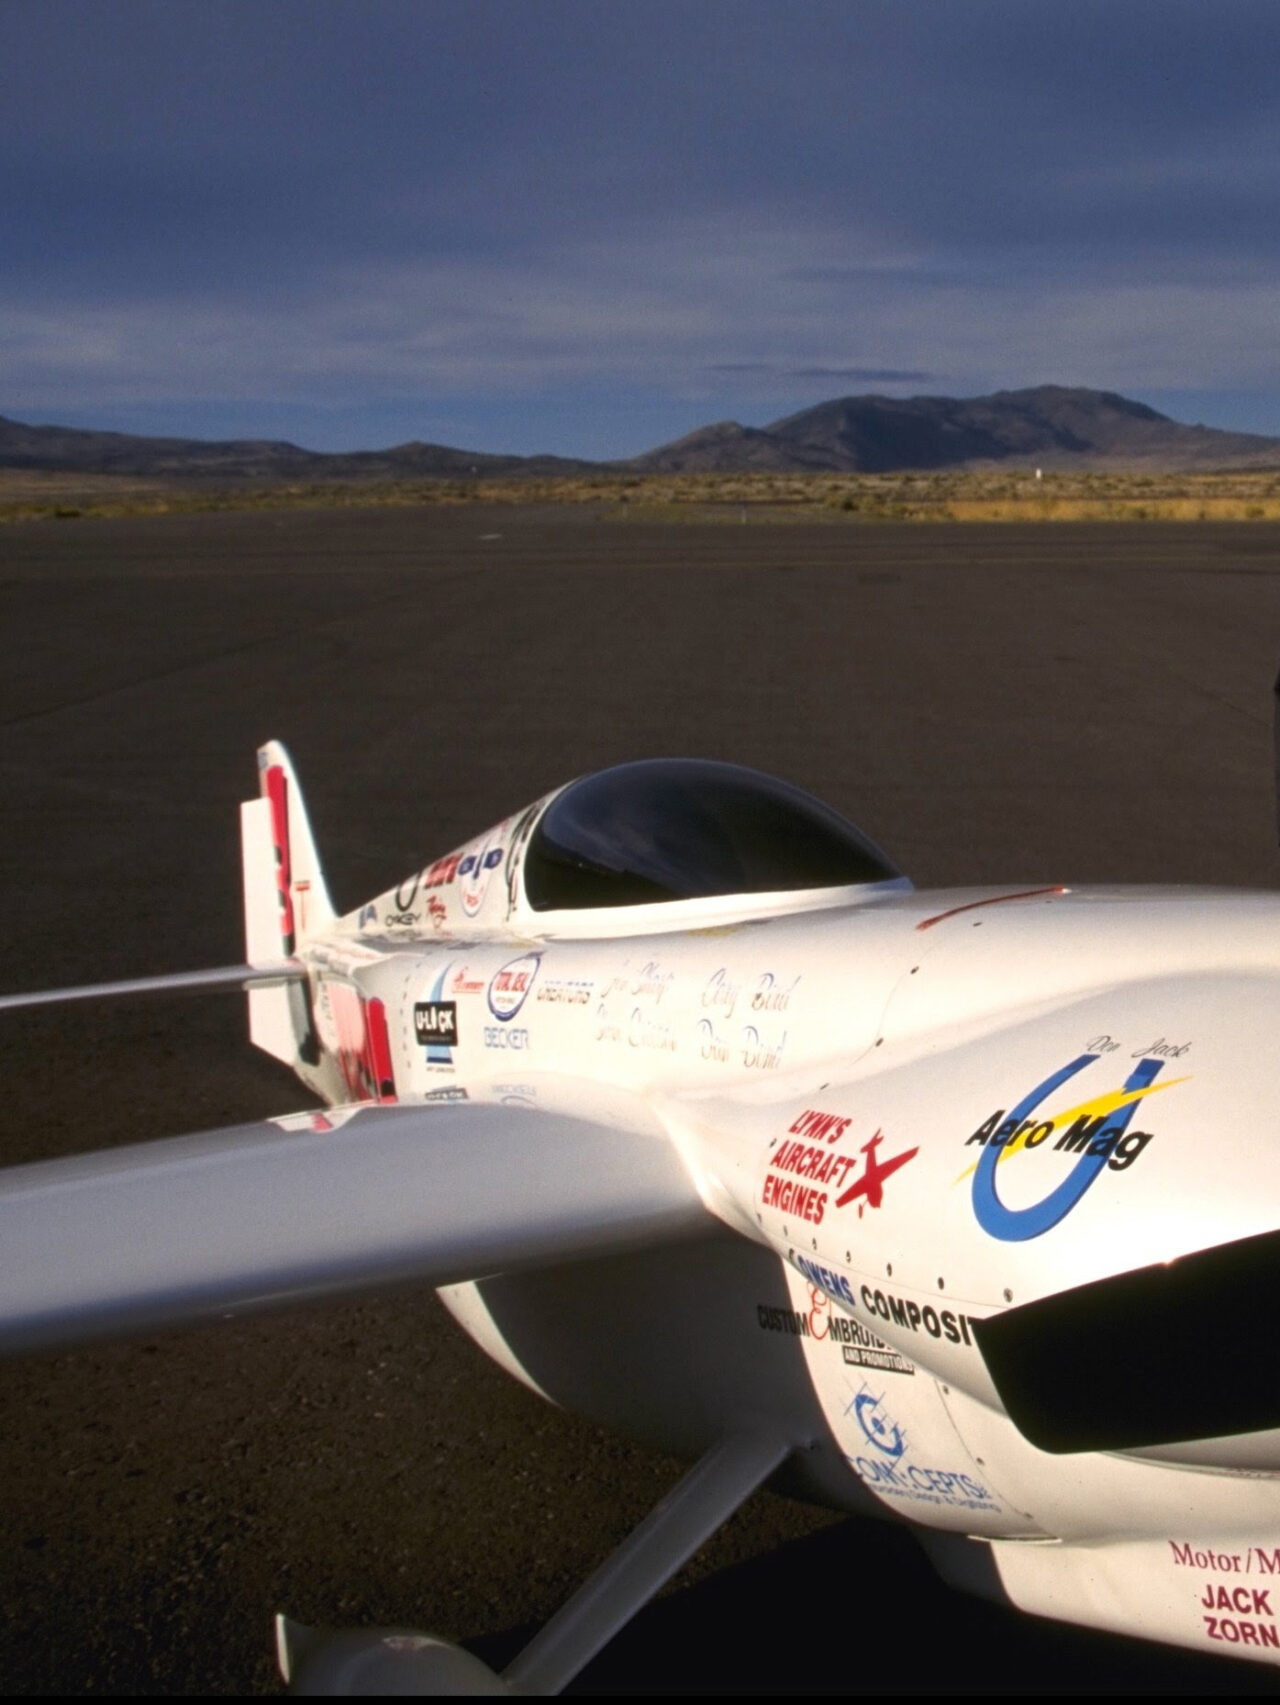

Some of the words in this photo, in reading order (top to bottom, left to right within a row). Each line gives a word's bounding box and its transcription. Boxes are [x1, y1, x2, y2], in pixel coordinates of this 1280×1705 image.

[484, 1026, 529, 1050] BECKER
[788, 1110, 852, 1144] LYNN'S
[964, 1110, 1055, 1149] Aero
[1053, 1114, 1154, 1171] Mag
[770, 1140, 857, 1188] AIRCRAFT
[762, 1174, 828, 1225] ENGINES
[757, 1303, 811, 1337] CUSTOM
[1202, 1584, 1274, 1616] JACK
[1202, 1615, 1280, 1648] ZORN
